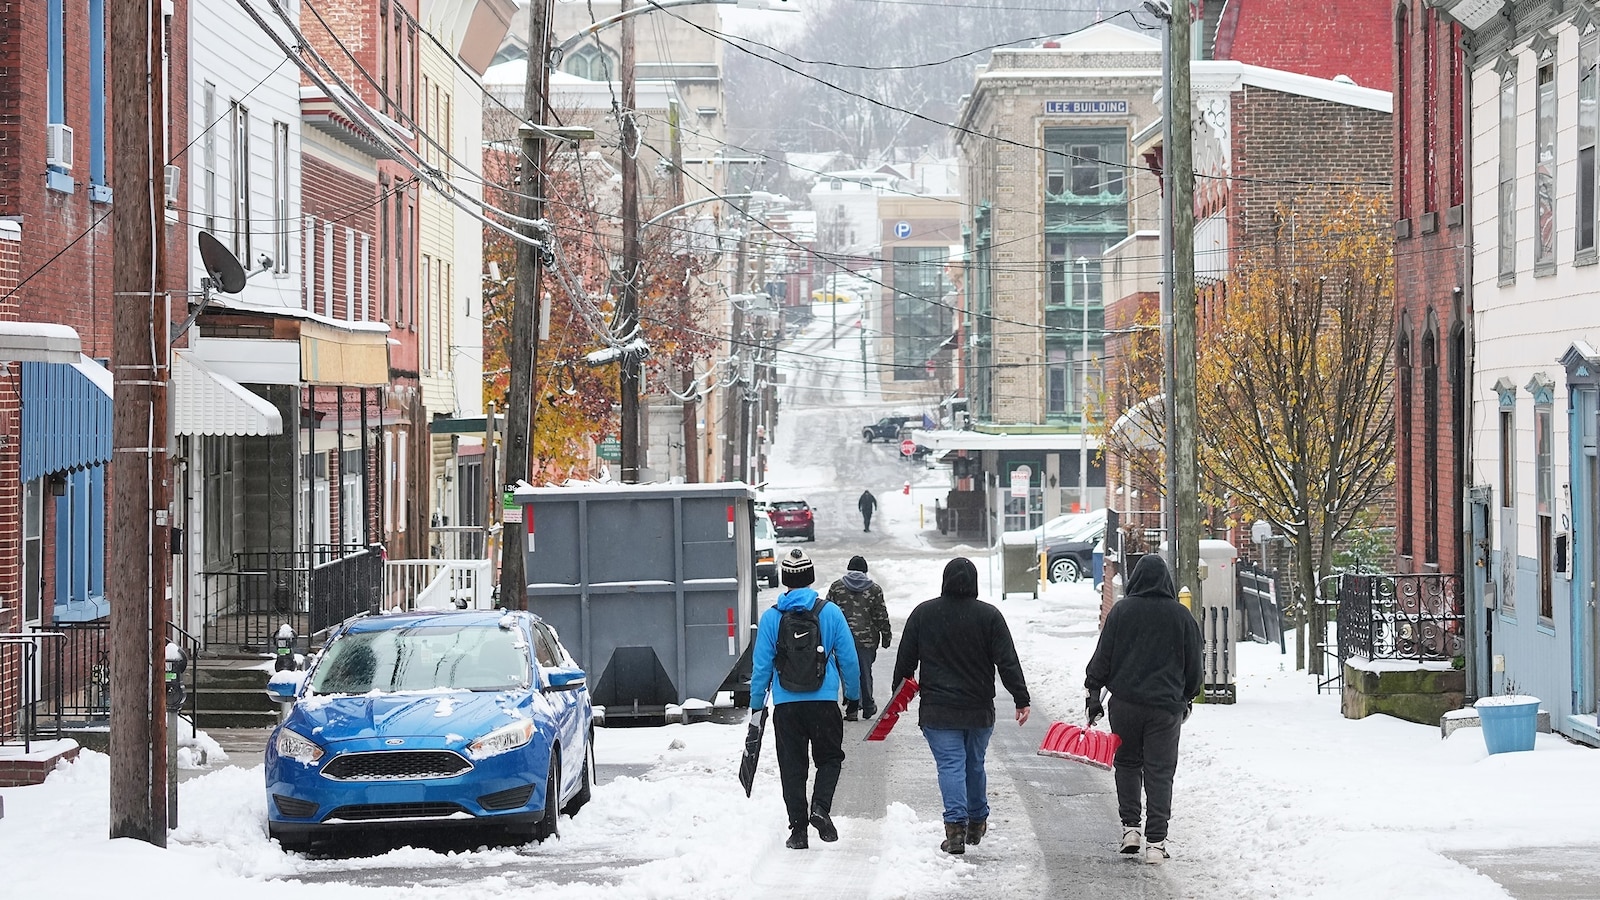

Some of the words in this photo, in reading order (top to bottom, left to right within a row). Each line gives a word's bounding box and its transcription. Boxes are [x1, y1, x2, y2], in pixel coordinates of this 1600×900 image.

[1048, 102, 1069, 112] LEE
[1073, 102, 1125, 112] BUILDING
[898, 223, 910, 237] P
